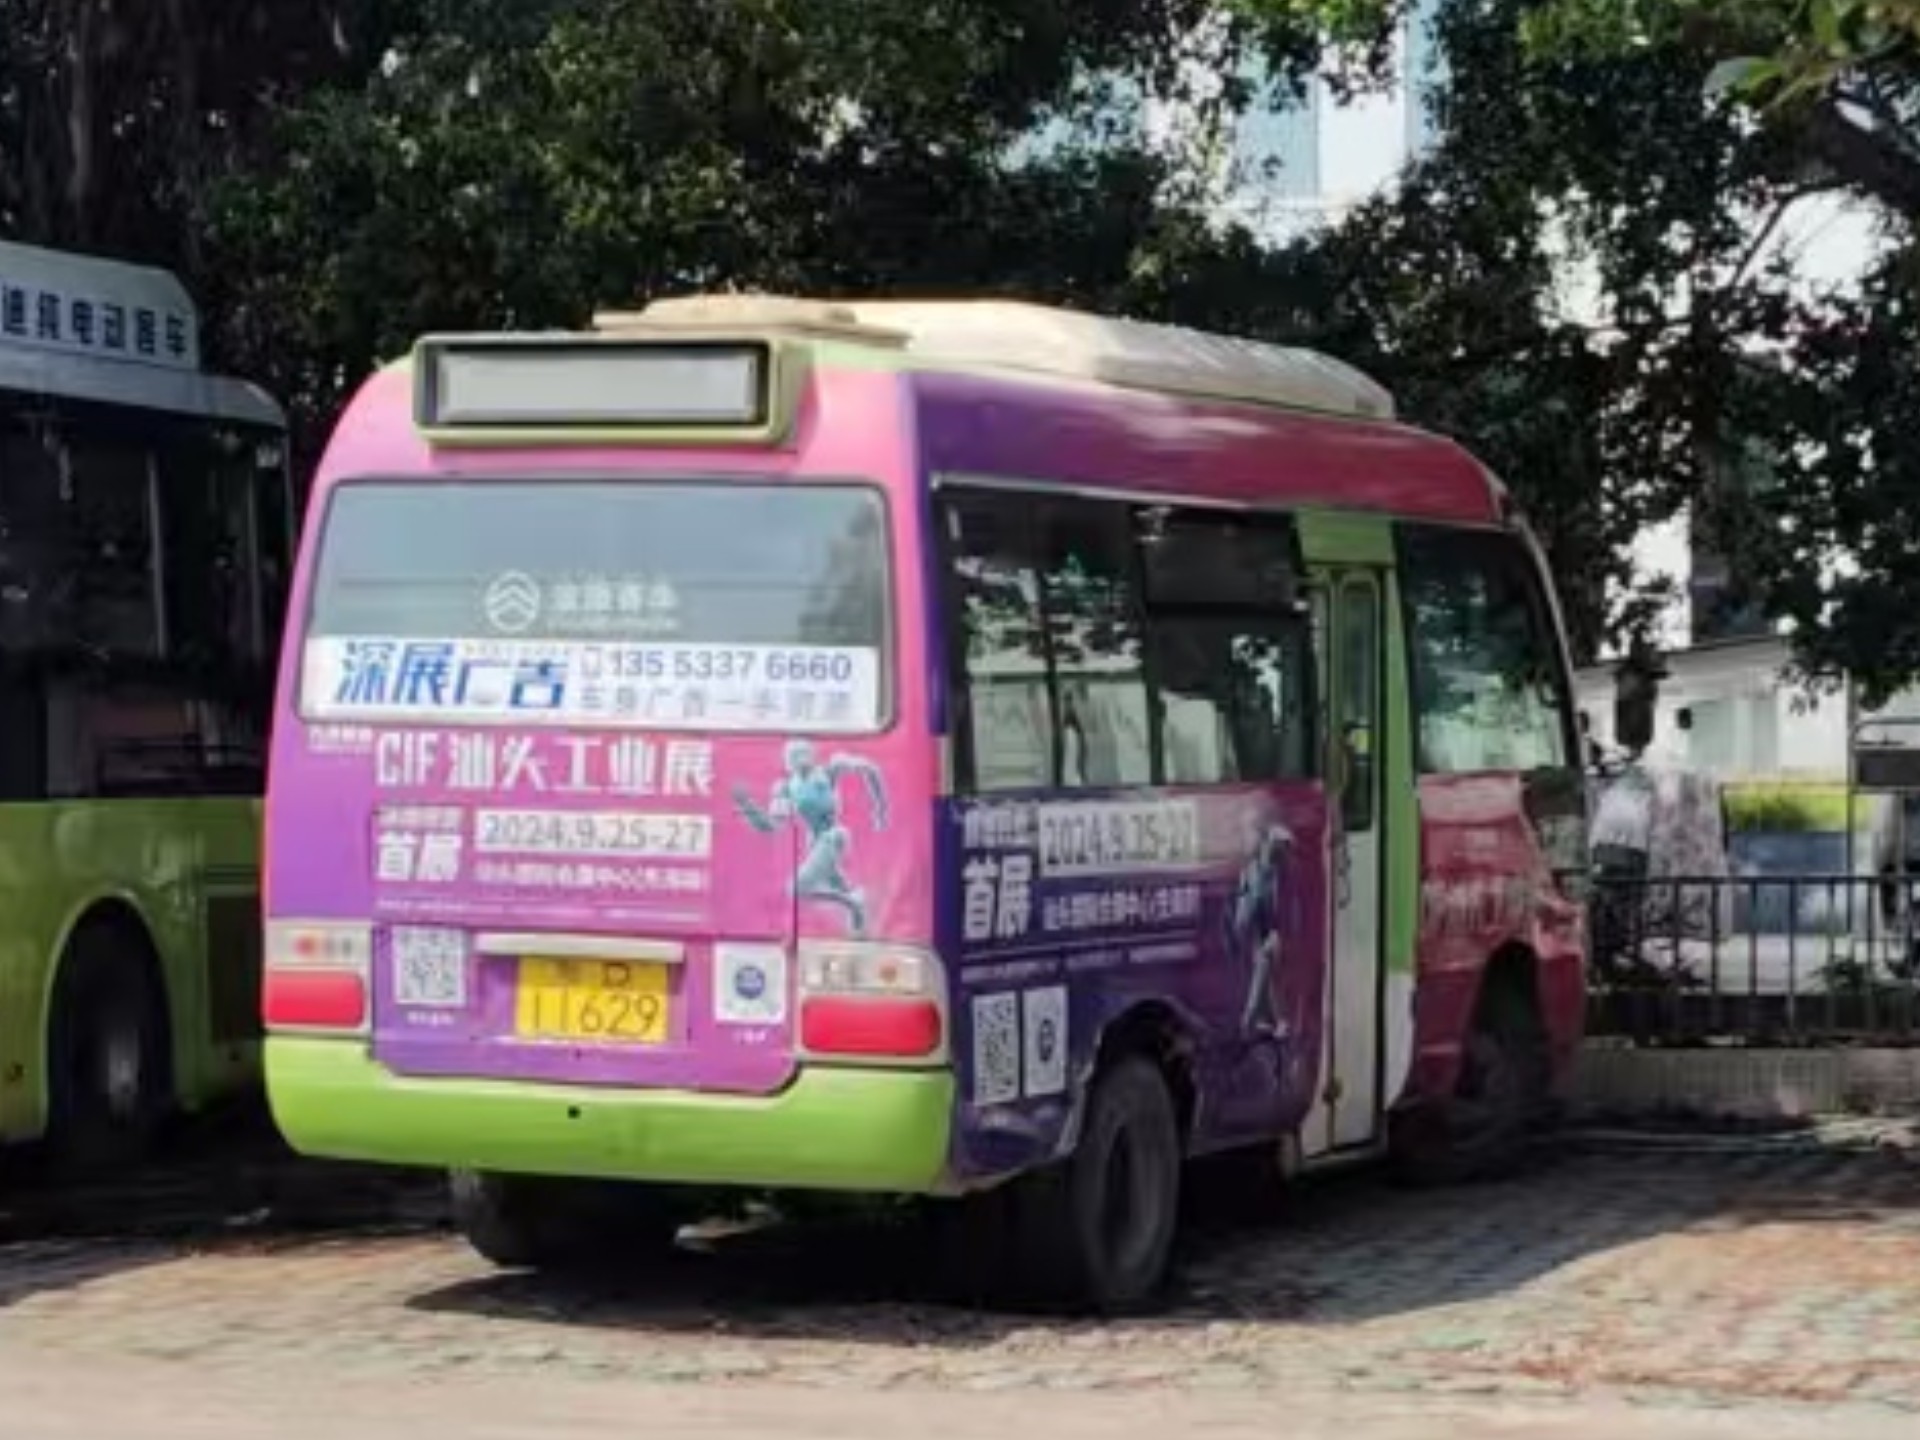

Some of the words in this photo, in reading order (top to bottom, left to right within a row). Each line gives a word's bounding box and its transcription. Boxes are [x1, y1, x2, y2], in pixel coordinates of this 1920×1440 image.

[335, 641, 569, 709] 深展广告
[612, 648, 664, 677] 135
[674, 650, 756, 678] 5337
[765, 653, 853, 681] 6660
[376, 731, 439, 787] CIF
[447, 731, 713, 796] 汕头工业展
[377, 831, 463, 882] 首展
[484, 813, 705, 853] 2024.9.25-27
[962, 853, 1032, 940] 首展
[534, 992, 660, 1035] 11629
